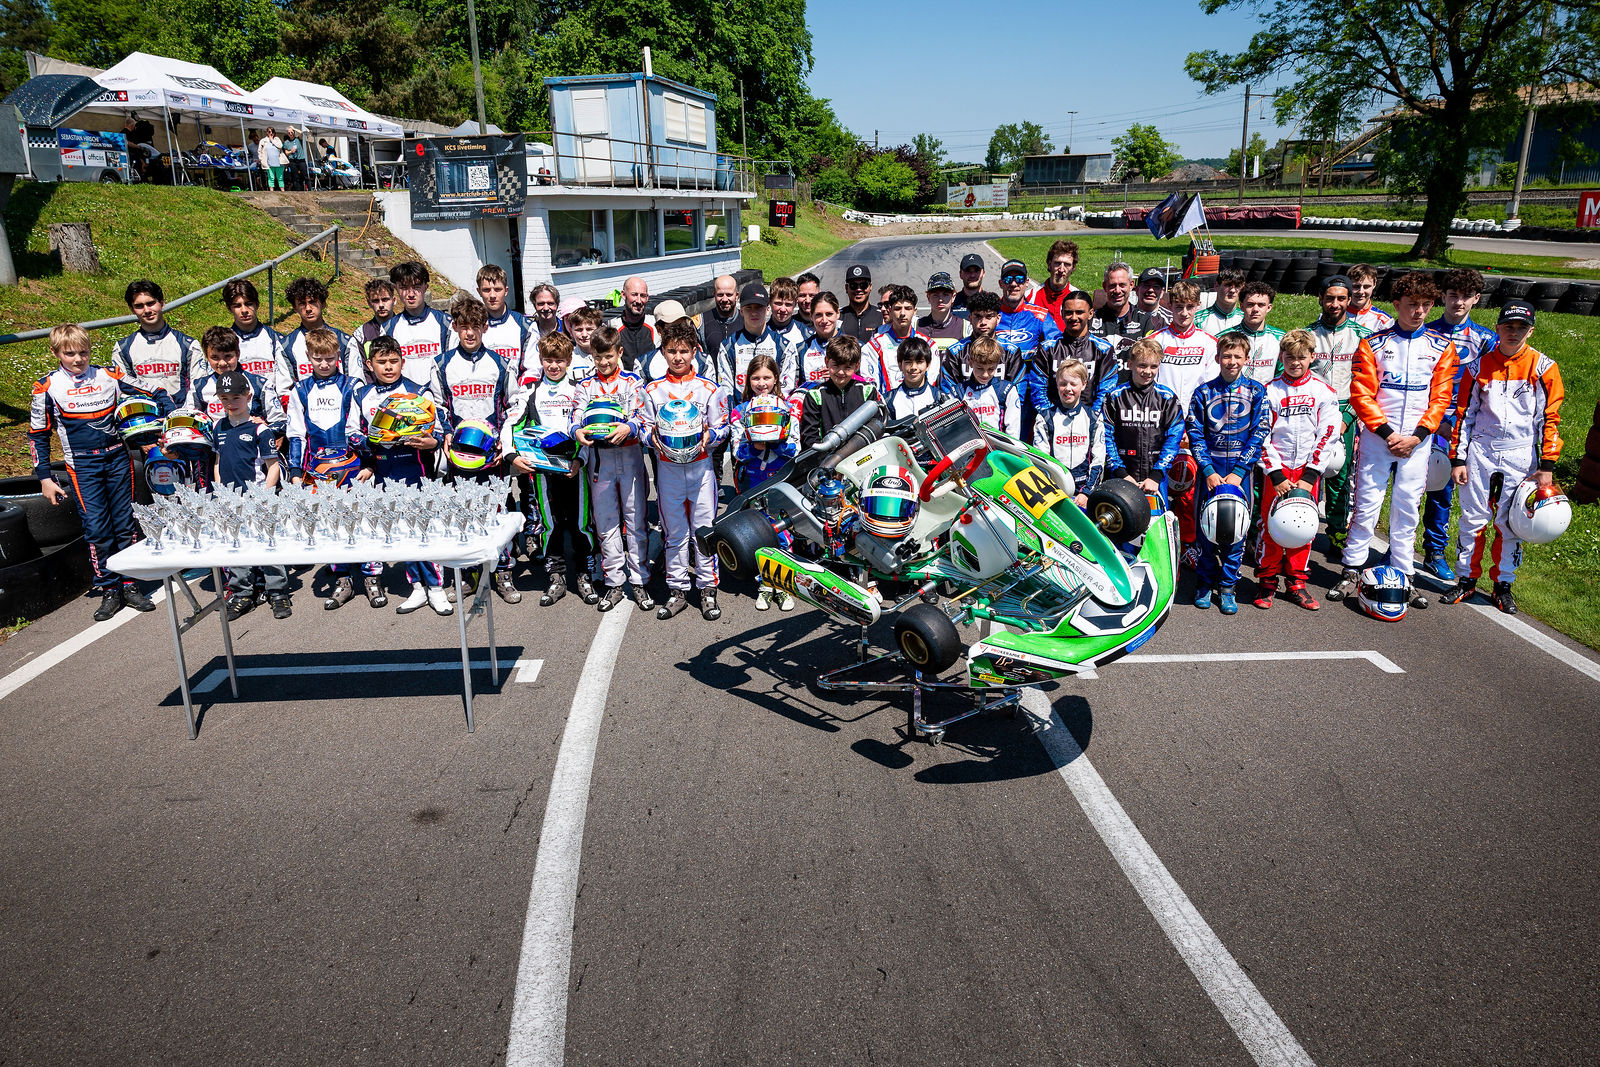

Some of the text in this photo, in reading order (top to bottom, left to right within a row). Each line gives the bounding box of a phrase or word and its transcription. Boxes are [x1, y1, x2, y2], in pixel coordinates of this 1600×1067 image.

[457, 143, 487, 151] livetiming
[1176, 347, 1204, 355] SWISS
[1162, 356, 1201, 364] HUTLESS
[136, 363, 180, 376] SPIRIT
[241, 361, 275, 372] PIRIT
[452, 384, 495, 397] SPIRIT
[76, 400, 109, 408] Swissquote
[316, 398, 335, 406] IWC
[973, 406, 995, 414] PIRIT
[1056, 436, 1088, 445] SPIRIT
[1015, 471, 1060, 508] 44
[1052, 547, 1104, 592] NIKI HASLER AG
[762, 559, 796, 596] 444
